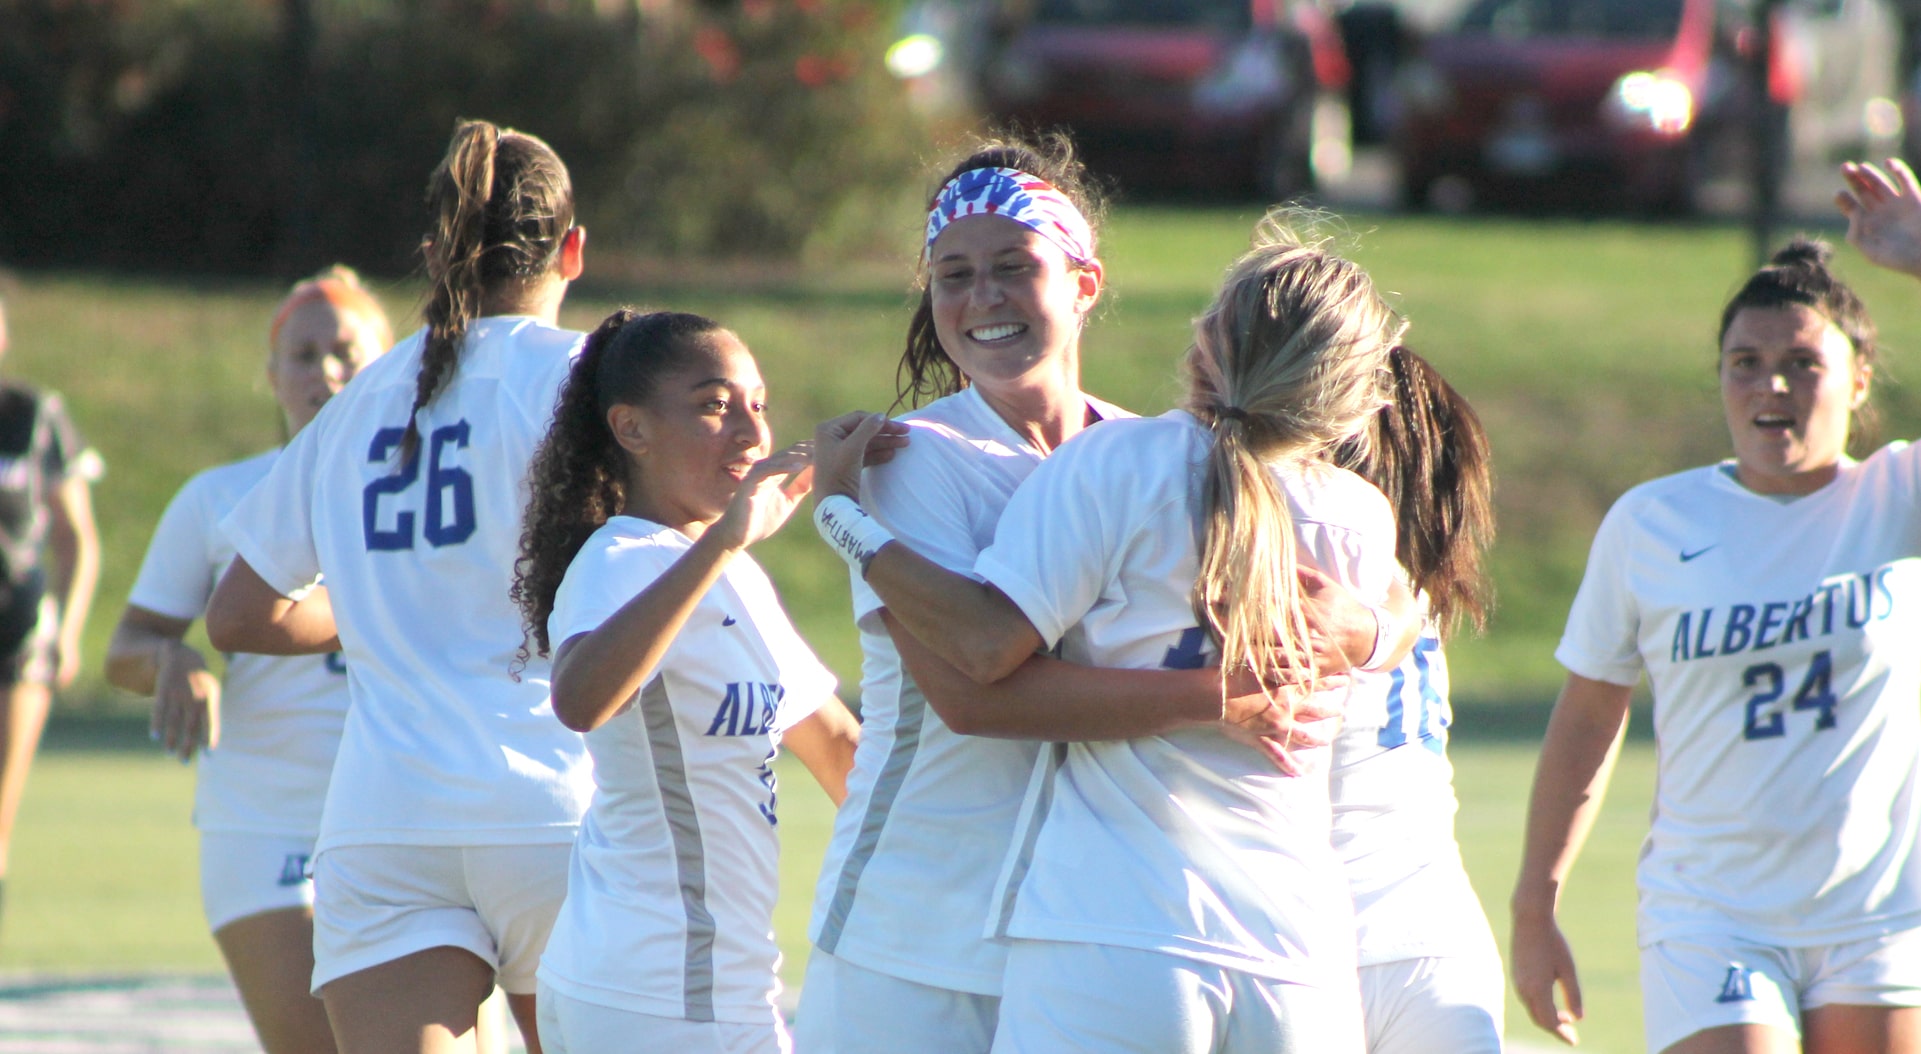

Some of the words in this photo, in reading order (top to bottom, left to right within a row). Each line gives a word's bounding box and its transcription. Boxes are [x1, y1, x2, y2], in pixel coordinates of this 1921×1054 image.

[363, 418, 477, 551] 26
[820, 507, 866, 564] MARTHA
[1672, 568, 1893, 662] ALBERTUS
[1744, 651, 1838, 741] 24
